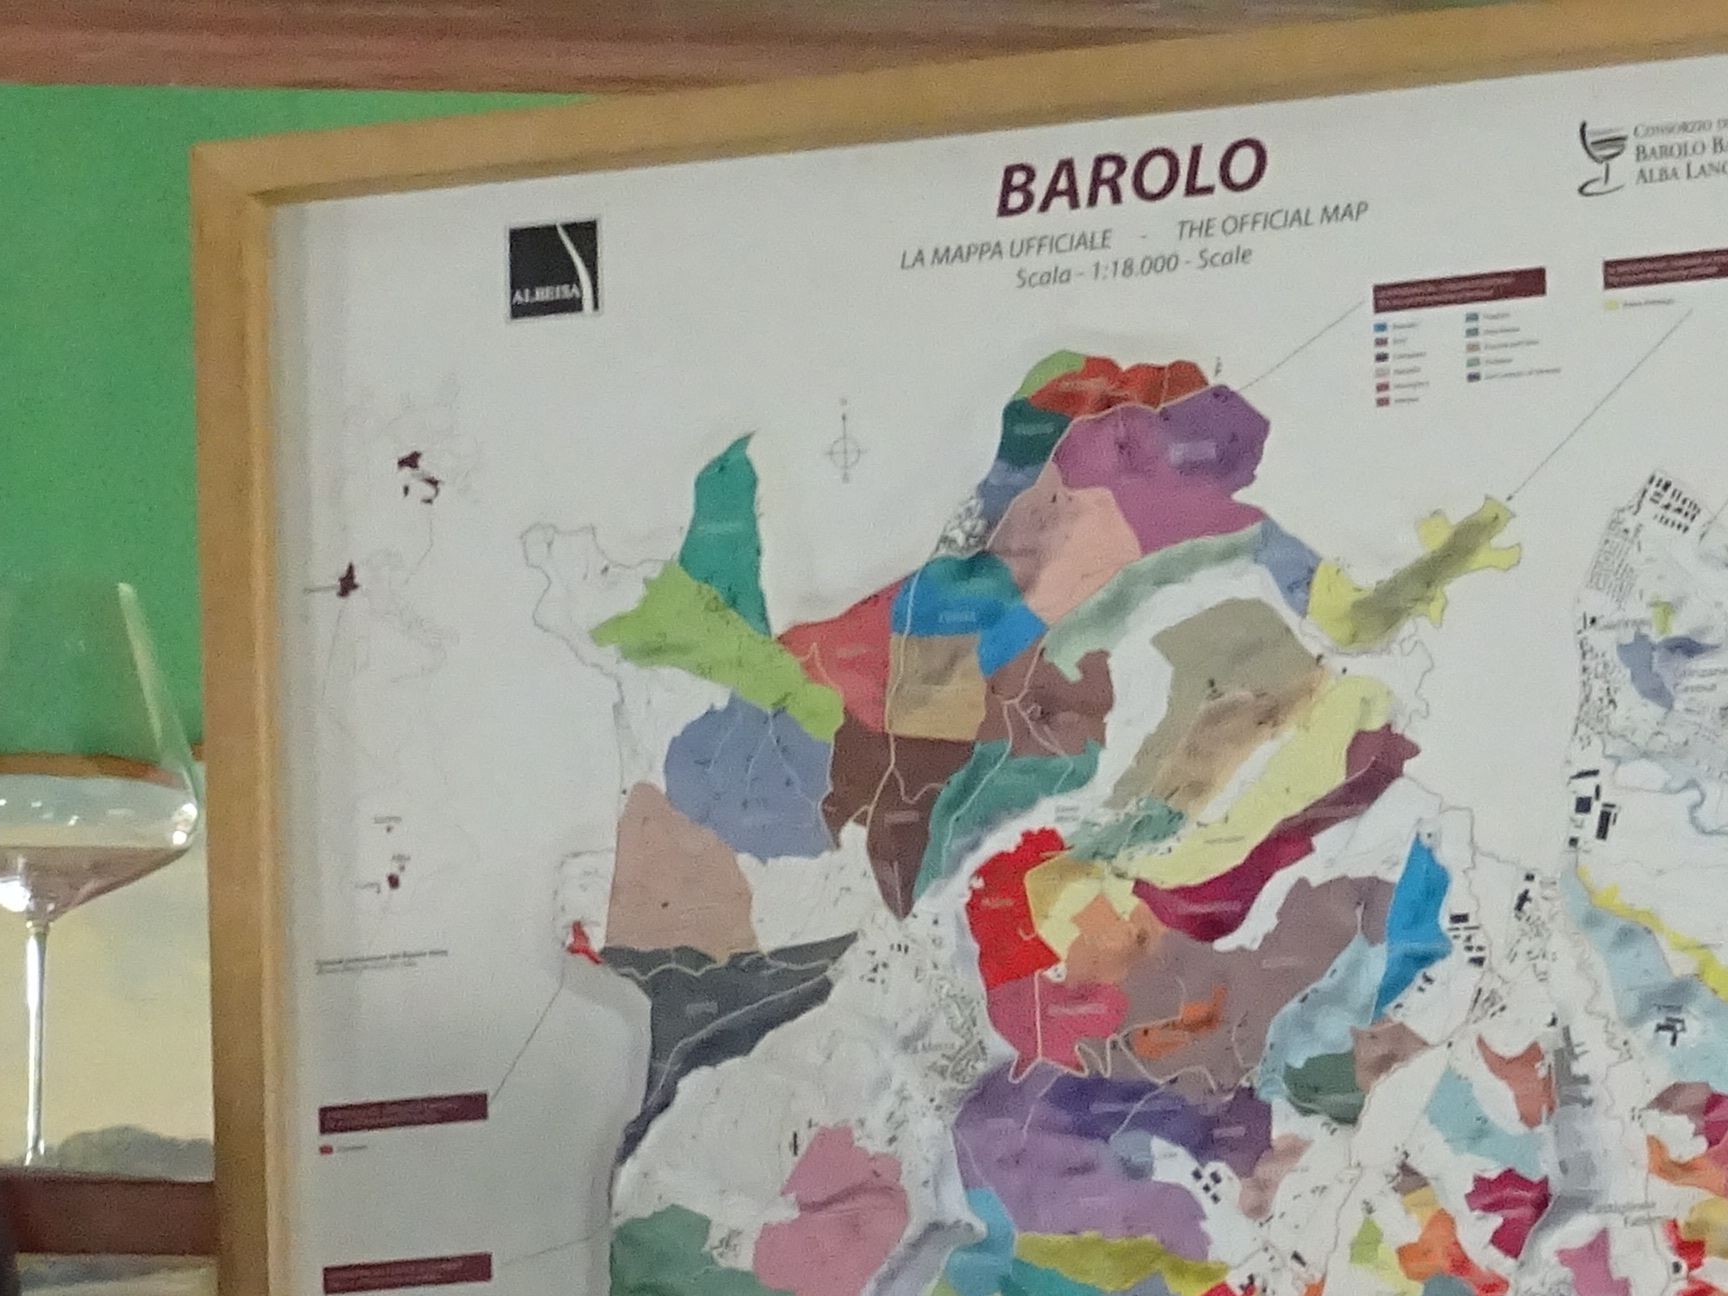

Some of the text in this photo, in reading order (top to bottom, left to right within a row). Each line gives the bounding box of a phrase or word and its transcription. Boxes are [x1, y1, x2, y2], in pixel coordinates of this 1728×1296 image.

[1635, 141, 1708, 163] BAROLO
[996, 137, 1268, 218] BAROLO
[1635, 166, 1680, 186] ALBA
[900, 247, 925, 270] LA
[931, 238, 1003, 267] MAPPA
[1008, 228, 1112, 260] UFFICIALE
[1177, 216, 1217, 241] THE
[1221, 207, 1314, 239] OFFICIAL
[1320, 200, 1370, 226] MAP
[1016, 265, 1072, 289] Scala
[1092, 251, 1179, 281] 1:18.000
[1198, 245, 1254, 270] Scale
